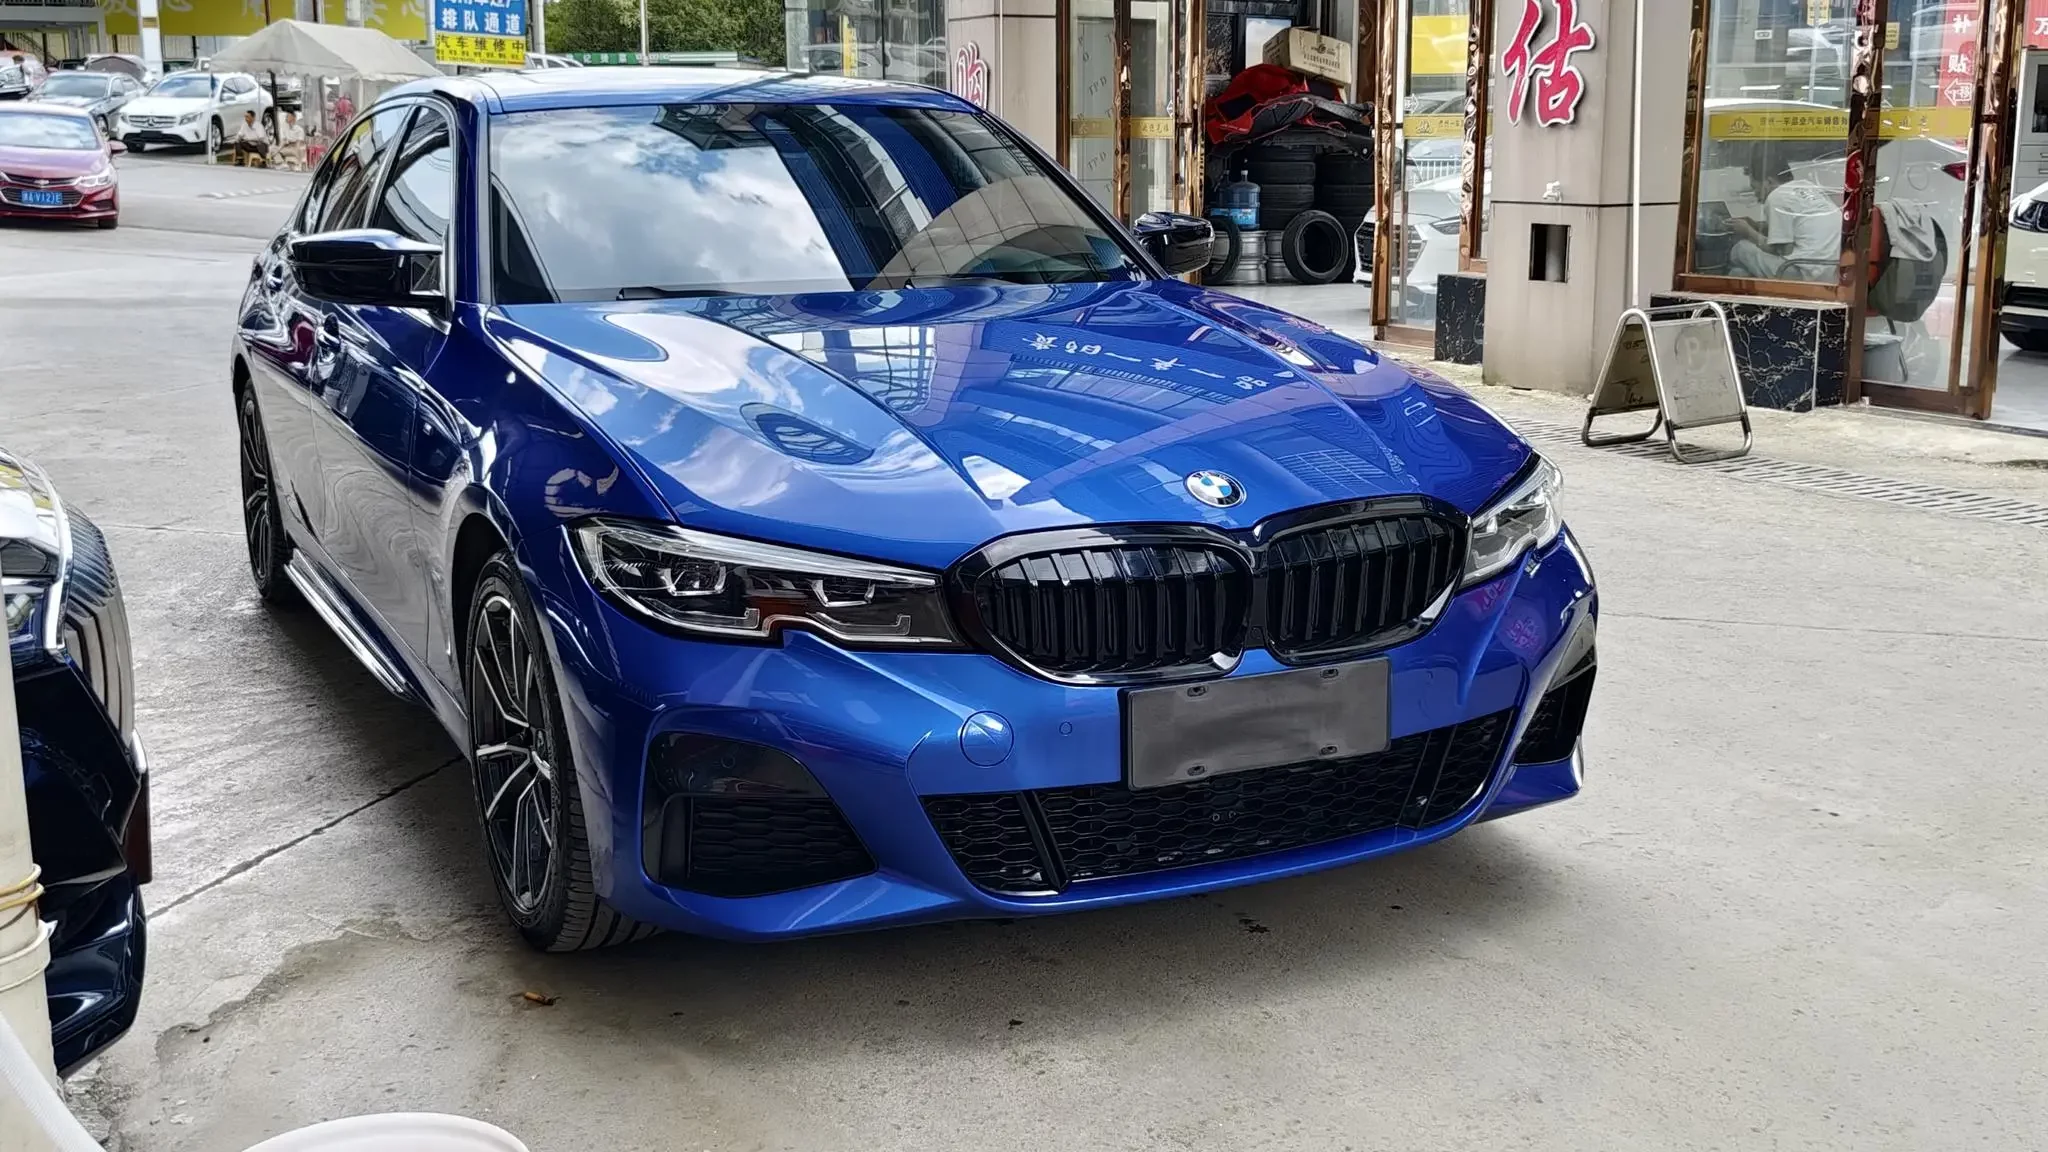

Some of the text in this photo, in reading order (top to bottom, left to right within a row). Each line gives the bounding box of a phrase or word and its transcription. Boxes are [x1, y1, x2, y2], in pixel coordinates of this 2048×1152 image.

[441, 8, 521, 34] 排队通道
[436, 34, 524, 53] 汽车维修中
[1501, 0, 1595, 127] 估
